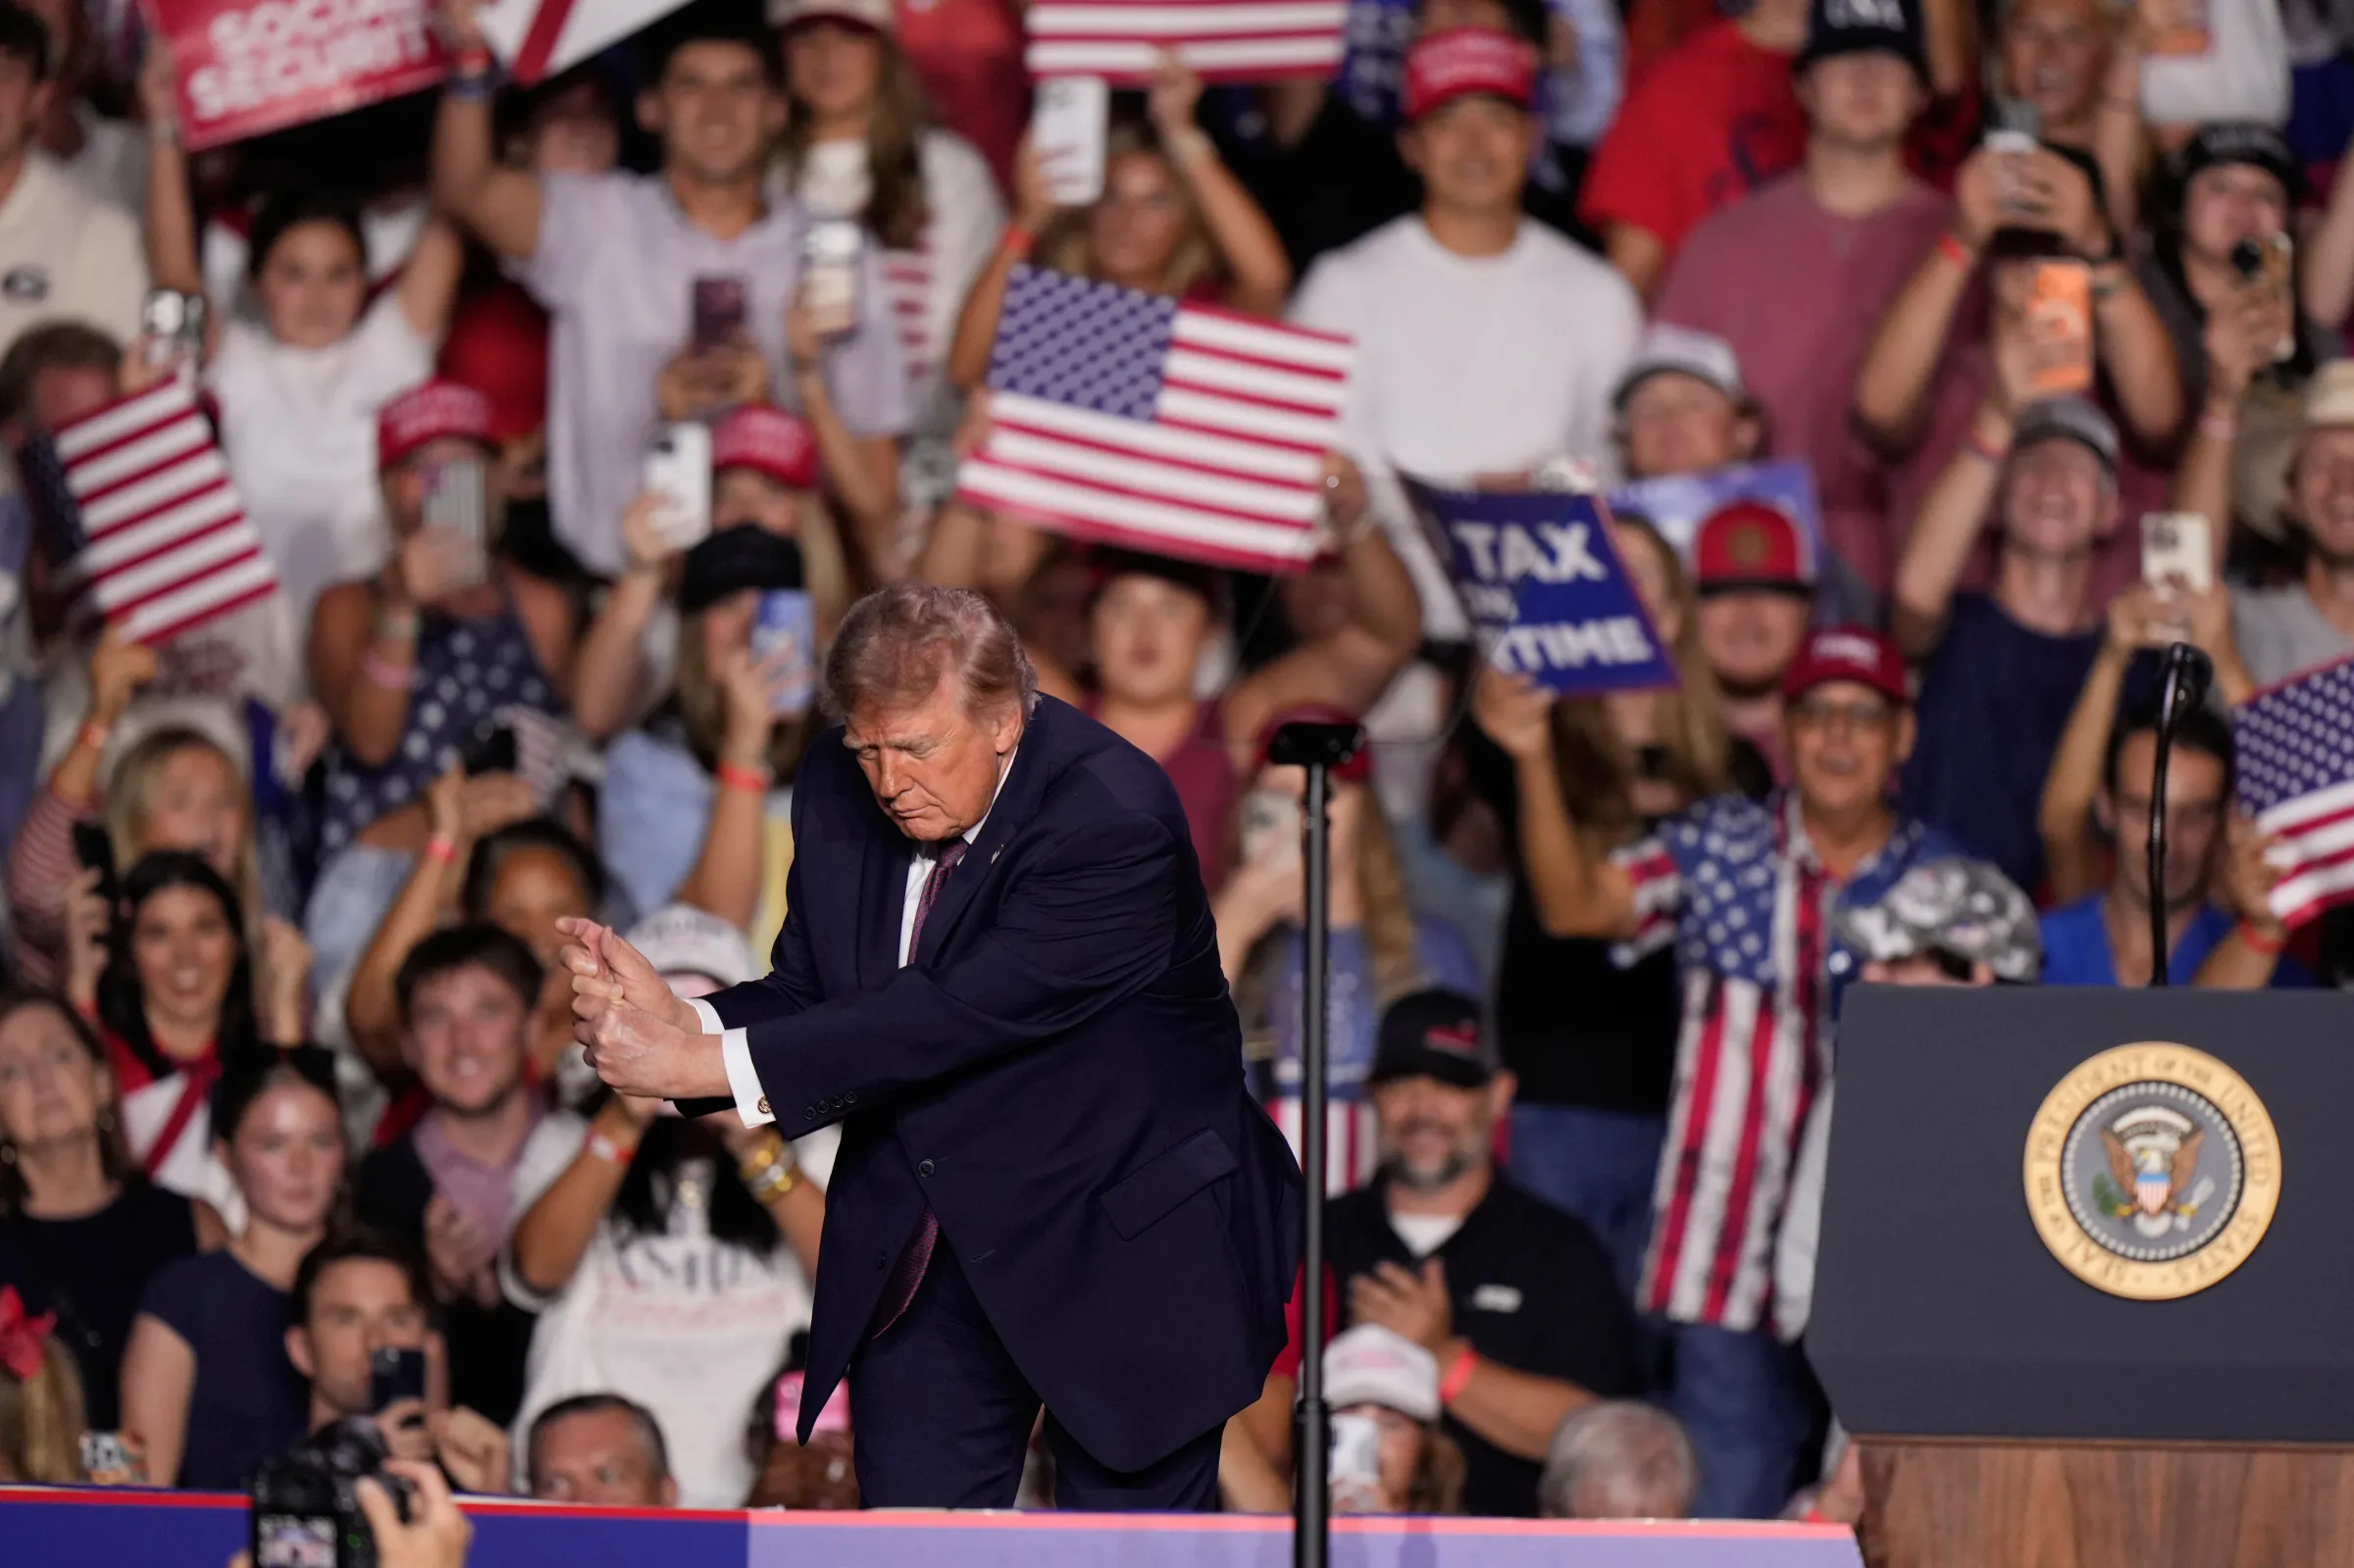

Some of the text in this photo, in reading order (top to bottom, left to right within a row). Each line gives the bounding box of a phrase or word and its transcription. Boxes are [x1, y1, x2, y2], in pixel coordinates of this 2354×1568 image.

[185, 12, 432, 121] SECURIT
[1450, 519, 1609, 583] TAX
[2036, 1051, 2145, 1162] PRESIDENT
[2220, 1082, 2272, 1188] UNITED
[2065, 1239, 2127, 1285] SEAL
[2173, 1208, 2261, 1289] STATES
